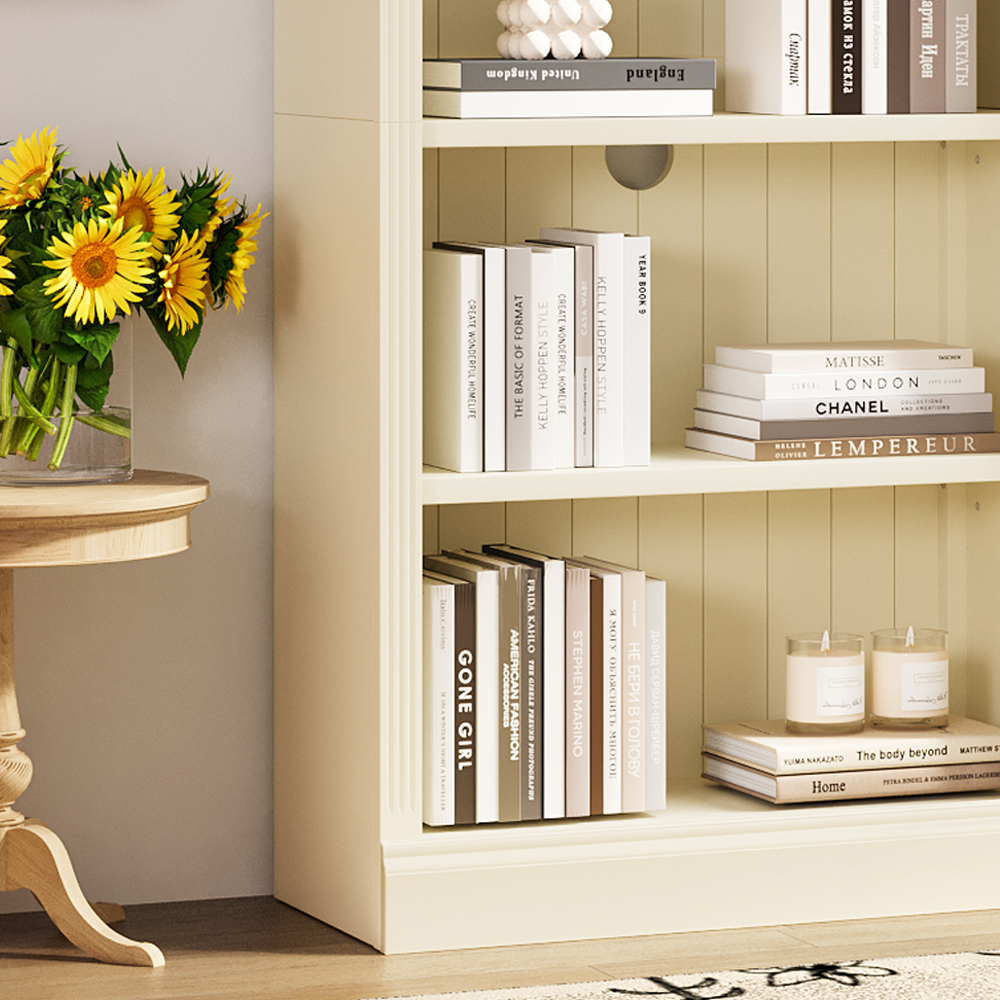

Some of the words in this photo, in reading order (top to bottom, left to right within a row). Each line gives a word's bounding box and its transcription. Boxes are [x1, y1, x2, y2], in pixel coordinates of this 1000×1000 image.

[919, 44, 938, 78] Иден
[956, 14, 970, 86] ТРАКТАТЫ
[486, 68, 538, 80] Kingdom
[541, 69, 580, 80] United
[626, 66, 685, 82] England
[638, 254, 647, 278] YEAR
[558, 294, 566, 322] CREATE
[580, 282, 588, 308] WABI
[597, 276, 606, 316] KELLY
[638, 281, 647, 306] BOOK
[468, 299, 476, 328] CREATE
[514, 295, 524, 340] FORMAT
[538, 302, 548, 338] STYLE
[580, 310, 588, 336] CASA
[468, 330, 476, 378] WONDERFUL
[514, 344, 524, 359] OF
[558, 326, 566, 374] WONDERFUL
[597, 320, 606, 372] HOPPEN
[826, 356, 885, 368] MATISSE
[514, 362, 524, 394] BASIC
[538, 342, 548, 389] HOPPEN
[468, 381, 476, 419] HOMELIFE
[558, 376, 566, 414] HOMELIFE
[597, 376, 606, 414] STYLE
[834, 376, 920, 392] LONDON
[514, 398, 524, 418] THE
[538, 394, 548, 430] KELLY
[816, 401, 889, 415] CHANEL
[814, 436, 976, 458] LEMPEREUR
[528, 579, 536, 612] FRIDA
[528, 616, 536, 654] KAHLO
[628, 642, 640, 661] НЕ
[510, 629, 520, 700] AMERICAN
[573, 630, 583, 696] STEPHEN
[458, 650, 473, 712] GONE
[502, 662, 510, 728] ACCESSORIES
[628, 665, 640, 702] БЕРИ
[628, 706, 640, 716] В
[510, 702, 520, 760] FASHION
[573, 700, 583, 757] MARINO
[458, 722, 473, 770] GIRL
[628, 720, 640, 778] ГОЛОВУ
[807, 756, 844, 764] NAKAZATO
[856, 750, 876, 761] The
[880, 748, 906, 761] body
[908, 745, 948, 760] beyond
[960, 746, 993, 754] MATTHEW
[812, 780, 846, 794] Home
